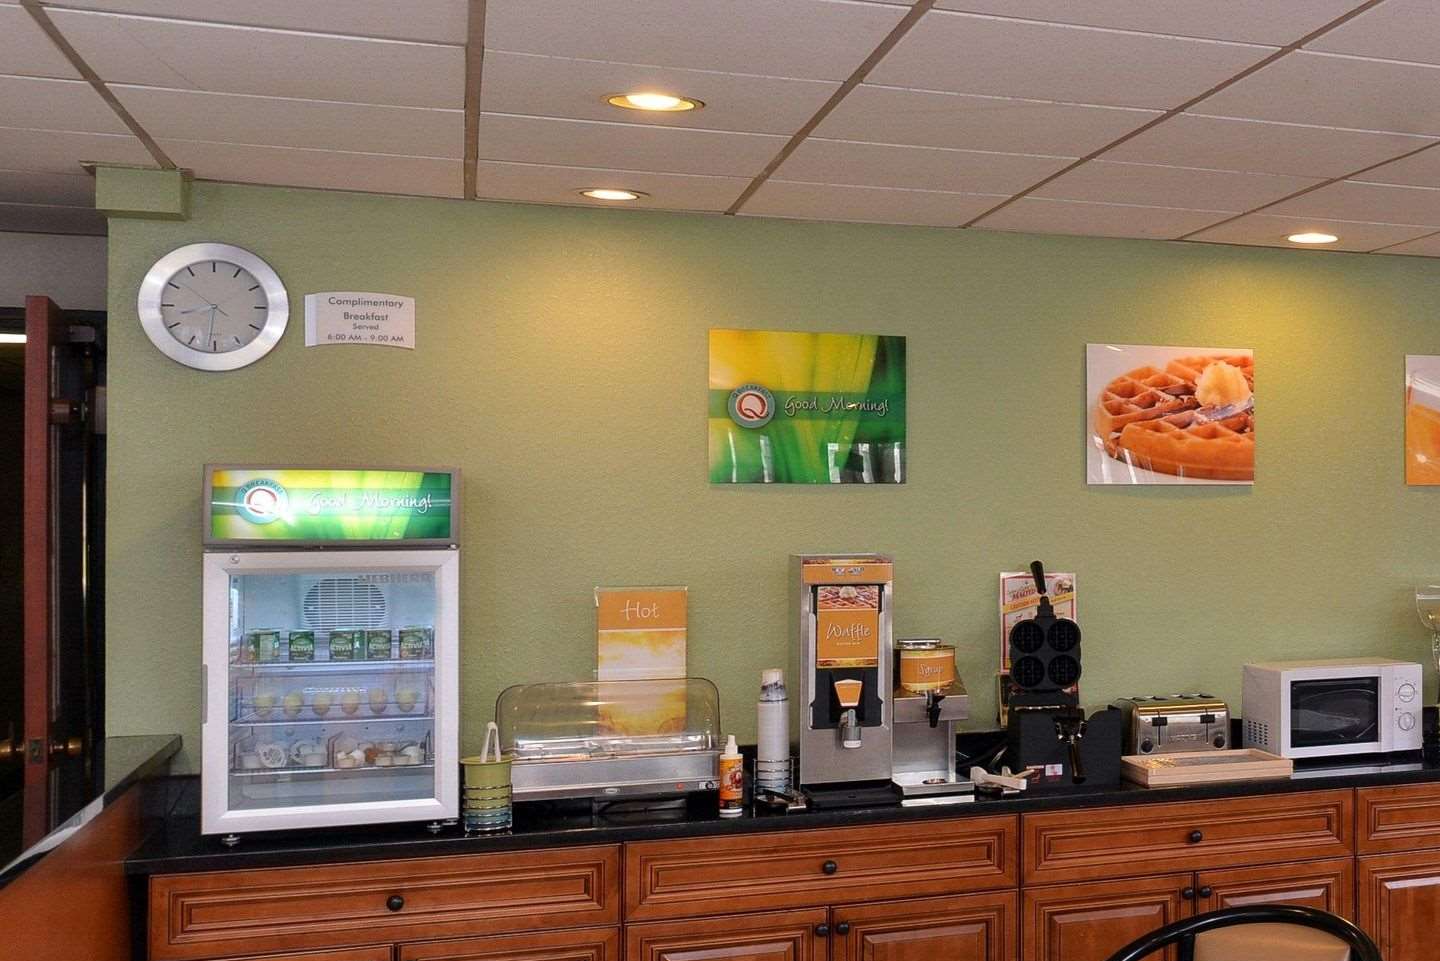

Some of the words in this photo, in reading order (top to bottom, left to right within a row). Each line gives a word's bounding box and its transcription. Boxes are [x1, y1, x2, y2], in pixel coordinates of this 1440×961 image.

[328, 297, 404, 309] Complimentary
[343, 312, 389, 321] Breakfast
[352, 323, 379, 331] Served
[784, 396, 818, 416] Good
[821, 396, 889, 417] Morning!
[352, 489, 433, 514] Morning!
[619, 599, 661, 621] Hot
[826, 623, 872, 642] Waffle
